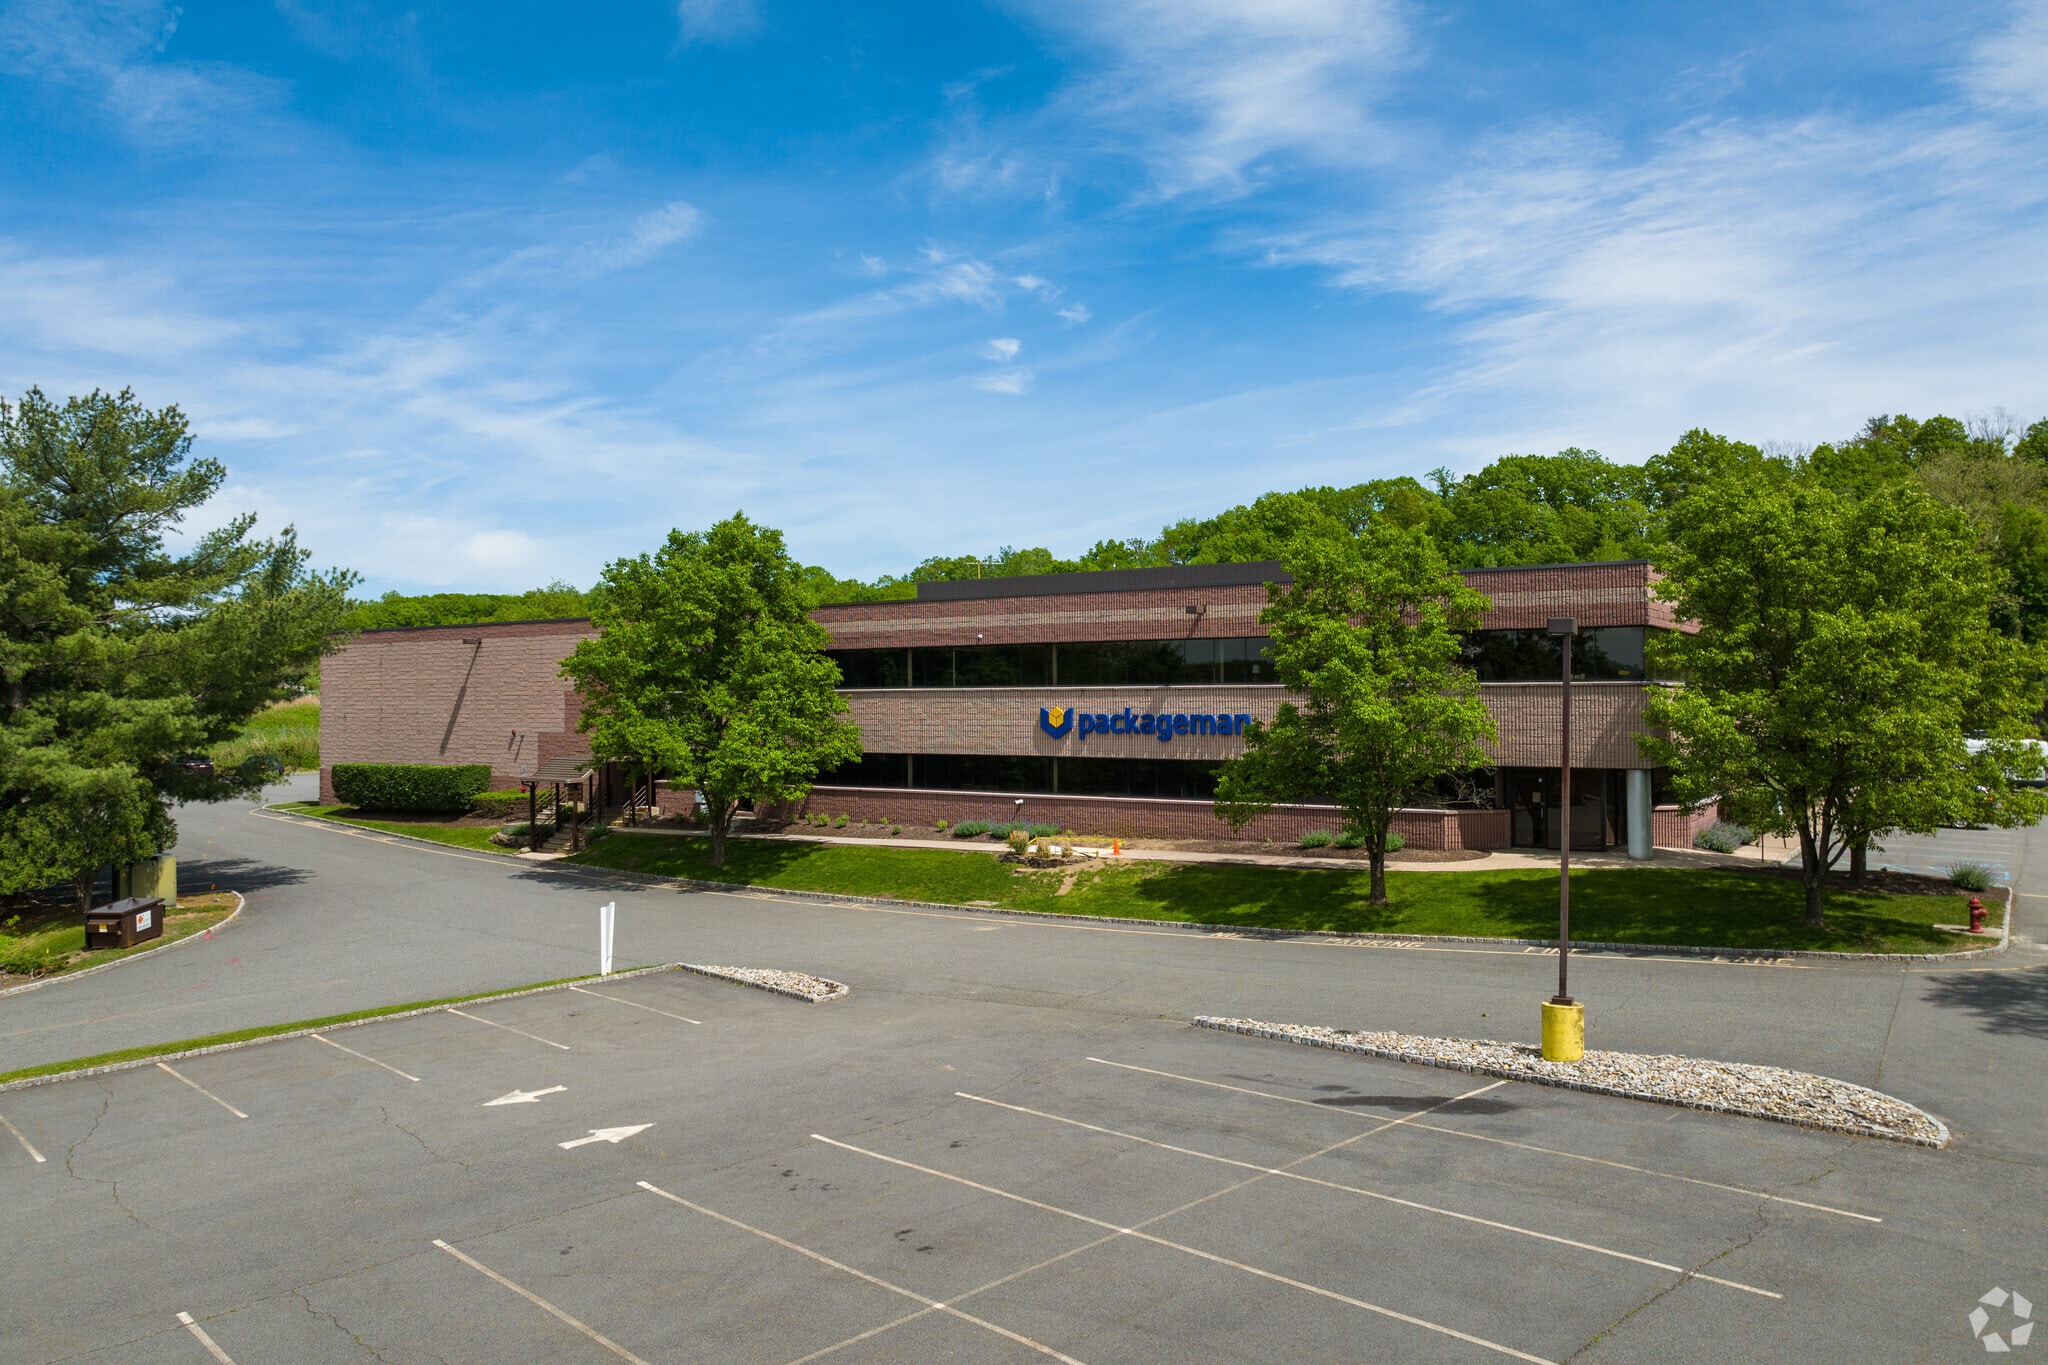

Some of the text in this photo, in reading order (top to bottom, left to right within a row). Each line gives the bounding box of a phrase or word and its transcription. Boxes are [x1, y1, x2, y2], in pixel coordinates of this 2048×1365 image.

[1078, 707, 1251, 742] packageman
[1321, 938, 1425, 948] PARKING
[1711, 955, 1796, 966] LANE
